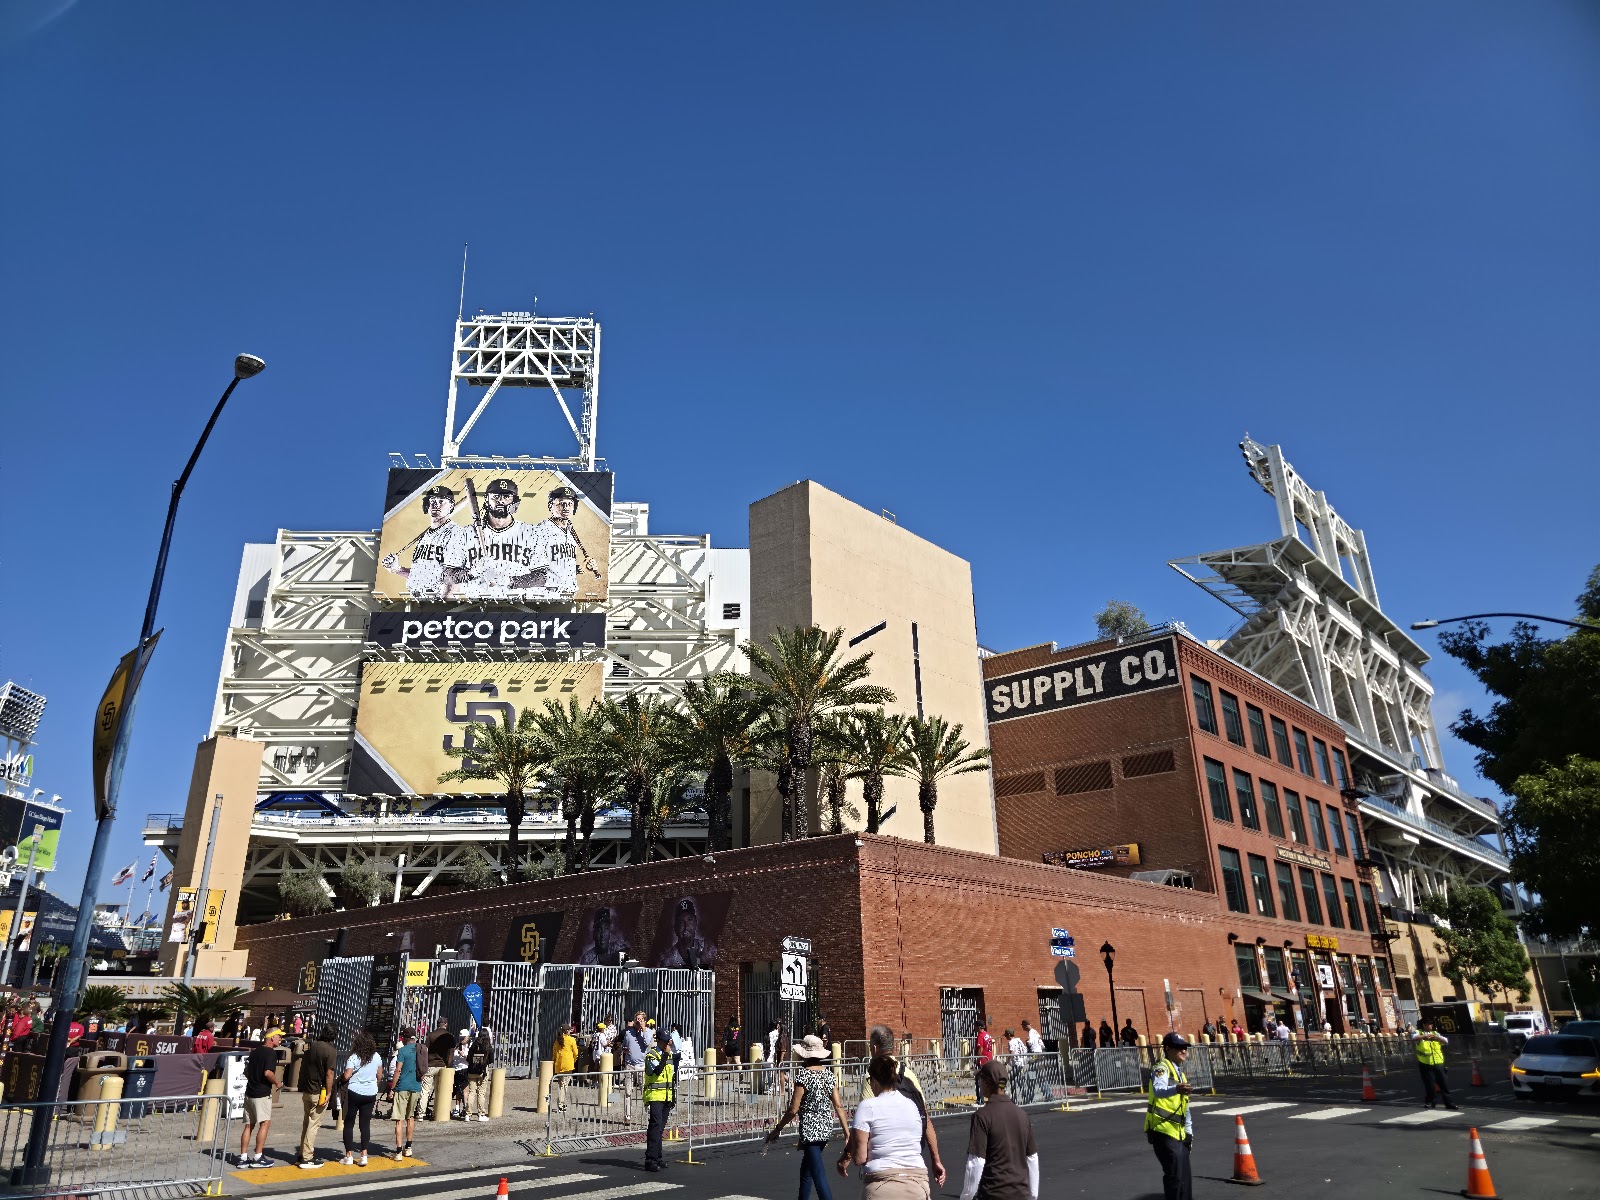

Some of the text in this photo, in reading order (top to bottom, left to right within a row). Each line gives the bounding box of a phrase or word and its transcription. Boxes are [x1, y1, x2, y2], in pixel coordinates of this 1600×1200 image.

[401, 615, 572, 644] petco park
[991, 649, 1176, 714] SUPPLY CO.
[1065, 849, 1101, 861] PONCHO
[520, 922, 540, 963] SD
[304, 960, 317, 991] SD
[138, 985, 149, 995] IN
[1440, 1015, 1456, 1033] SD
[155, 1041, 179, 1054] SEAT
